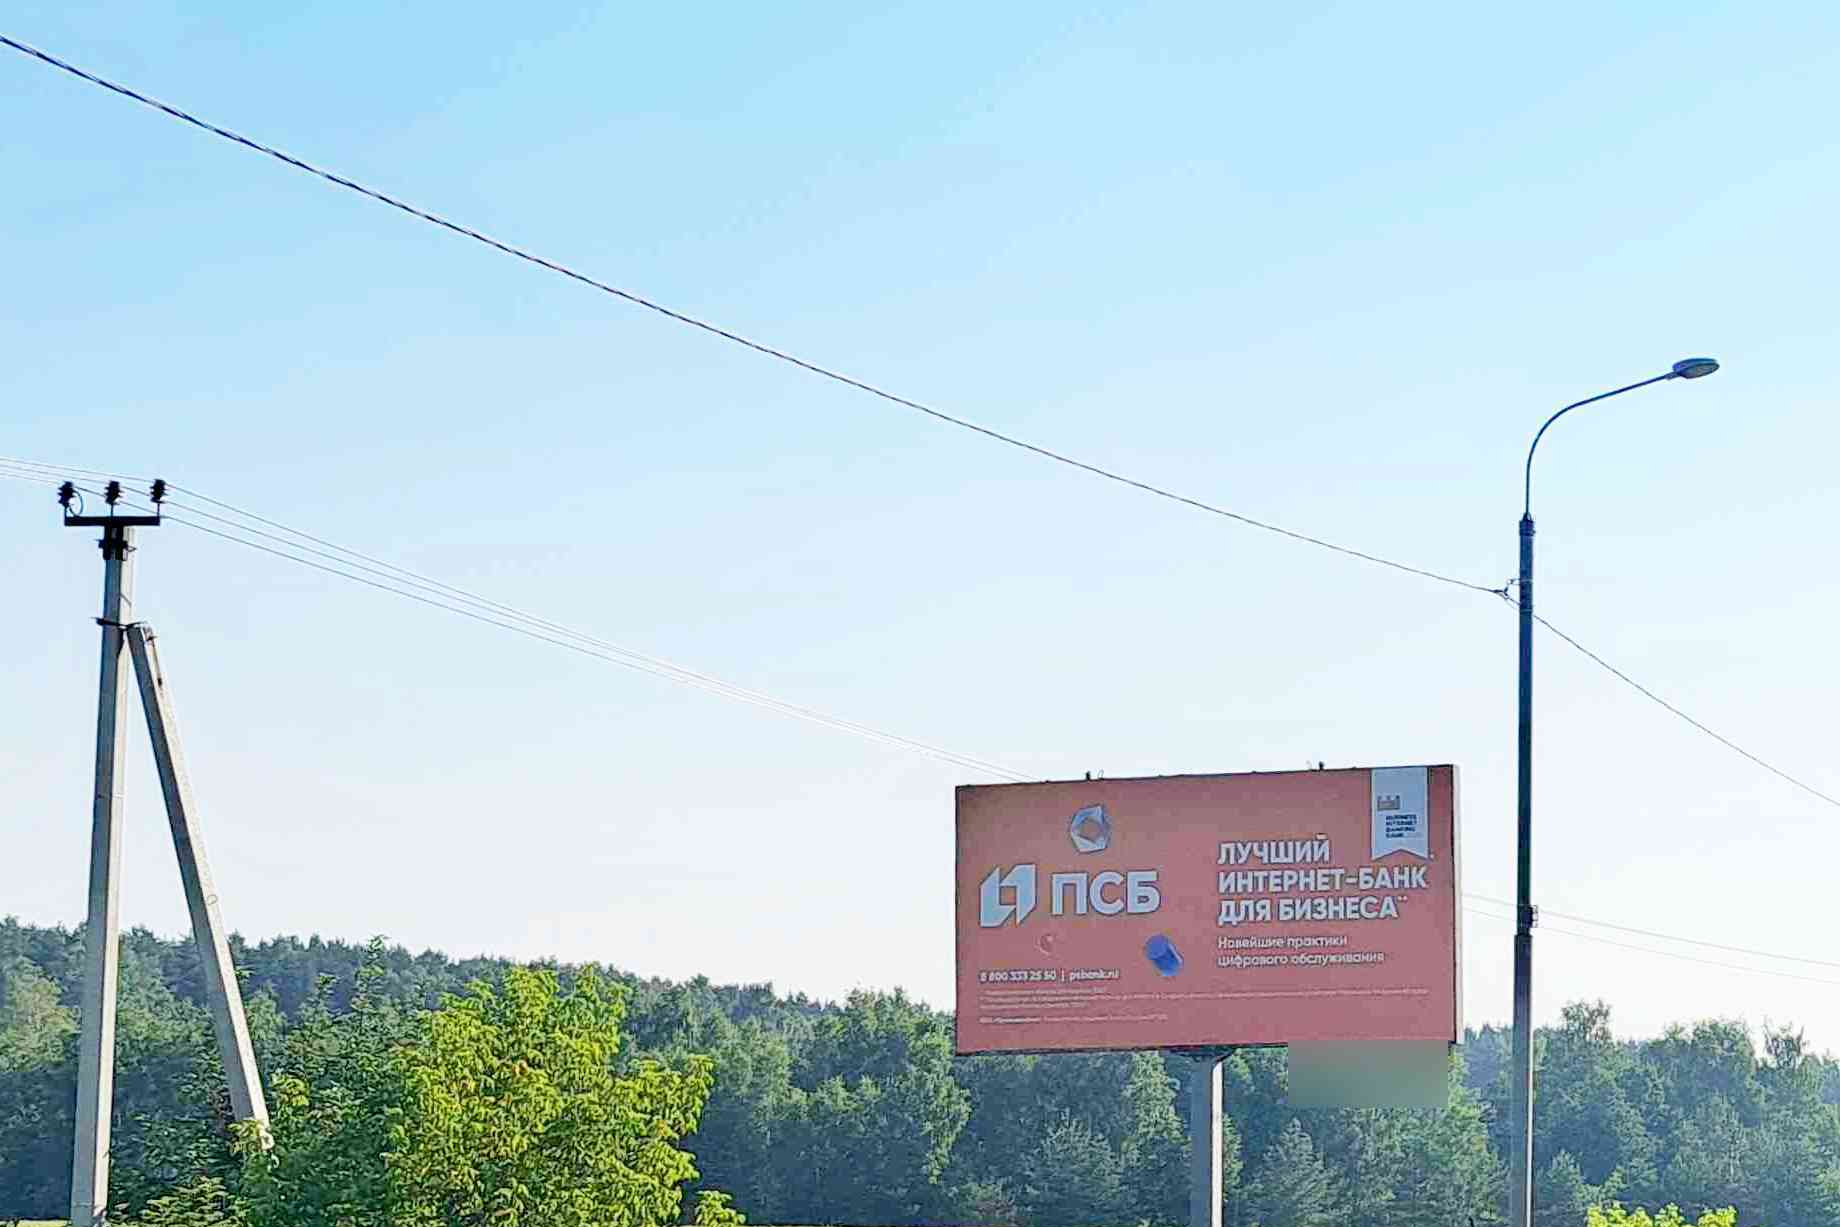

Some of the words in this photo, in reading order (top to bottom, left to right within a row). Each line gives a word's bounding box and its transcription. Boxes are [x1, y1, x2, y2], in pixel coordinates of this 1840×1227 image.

[1217, 833, 1330, 864] ЛУЧШИЙ
[1051, 871, 1161, 916] ПСБ
[1217, 866, 1428, 894] ИНТЕРНЕТ-БАНК
[1217, 898, 1271, 926] ДЛЯ
[1217, 935, 1284, 949] Новейшие
[1286, 934, 1348, 949] практики
[1217, 953, 1288, 968] цифрового
[1291, 951, 1385, 966] обслуживания
